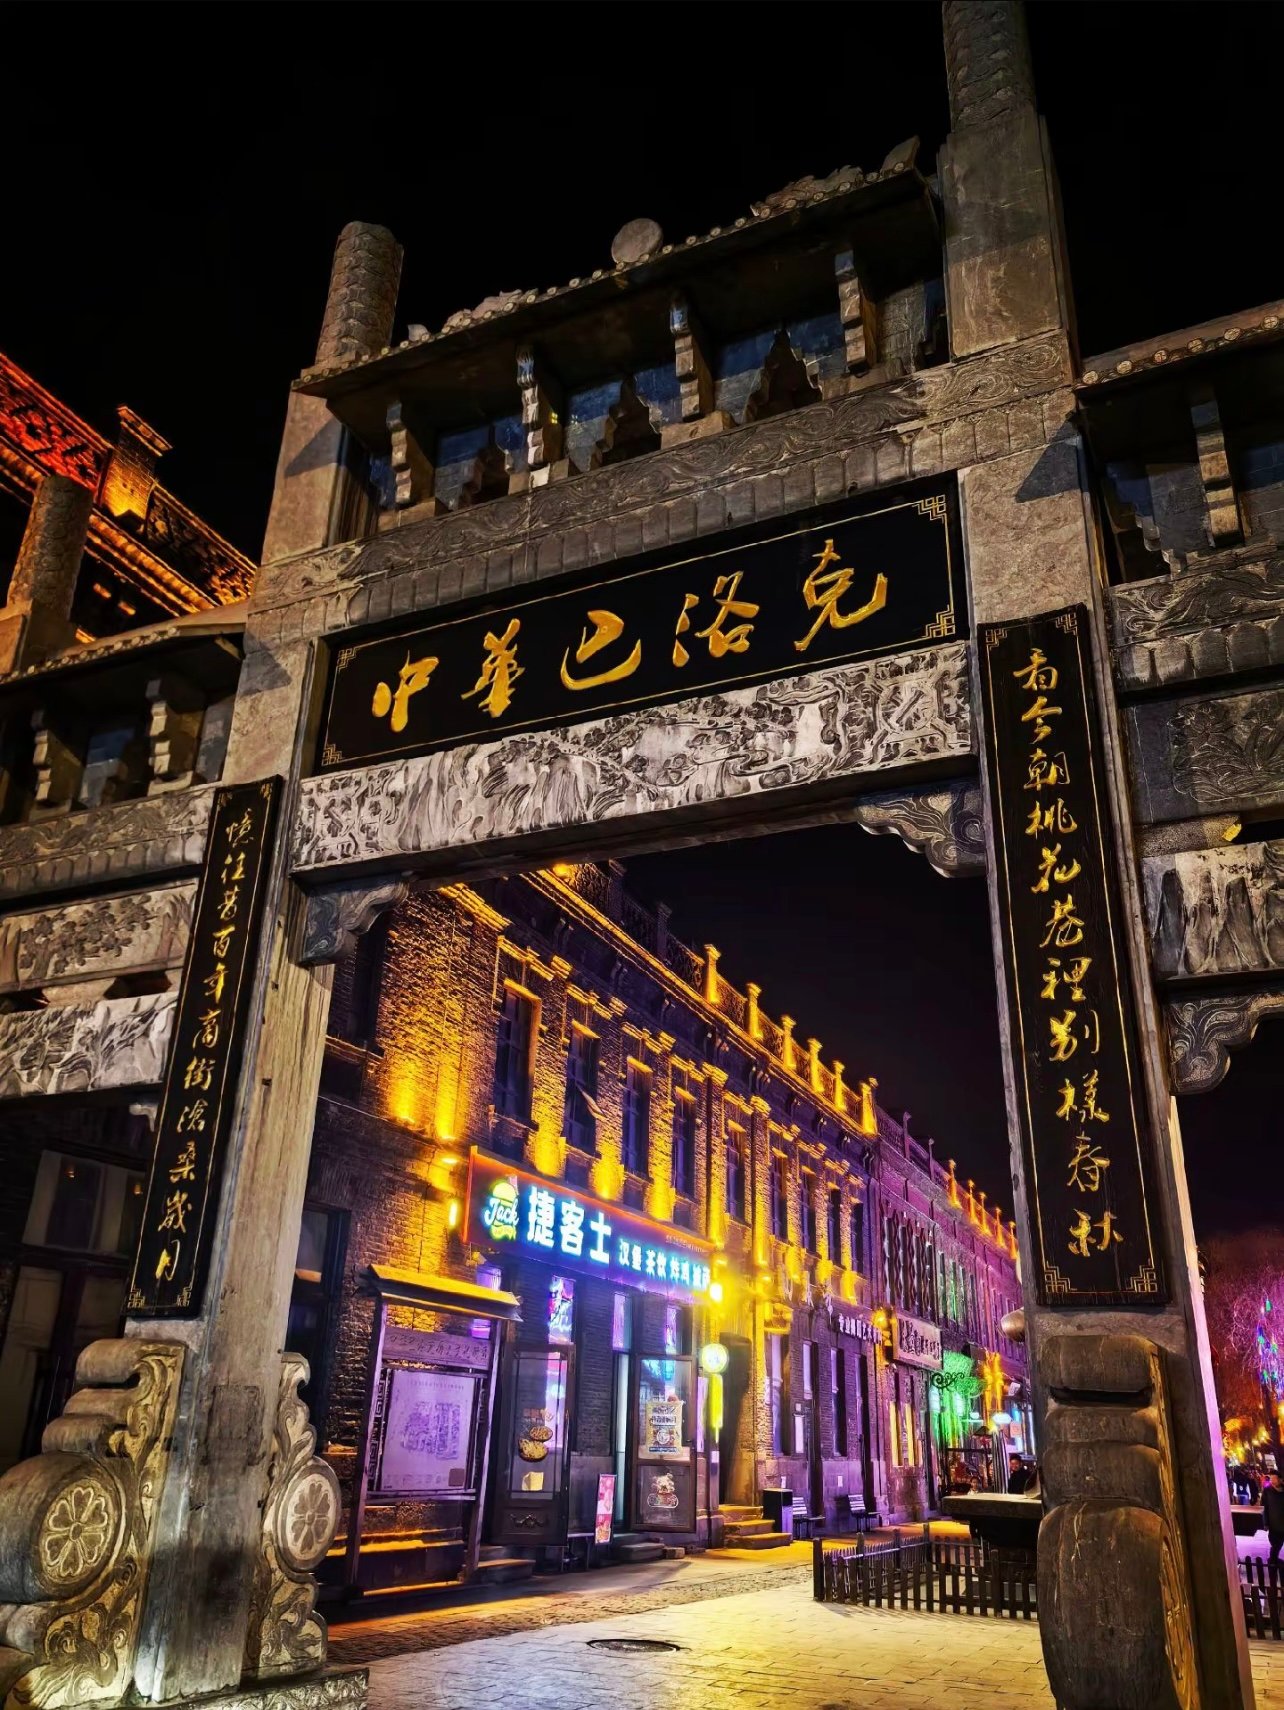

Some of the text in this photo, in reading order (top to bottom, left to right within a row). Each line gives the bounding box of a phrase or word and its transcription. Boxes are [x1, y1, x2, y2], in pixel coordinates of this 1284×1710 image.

[484, 1197, 519, 1226] Jack
[527, 1185, 612, 1264] 捷客士
